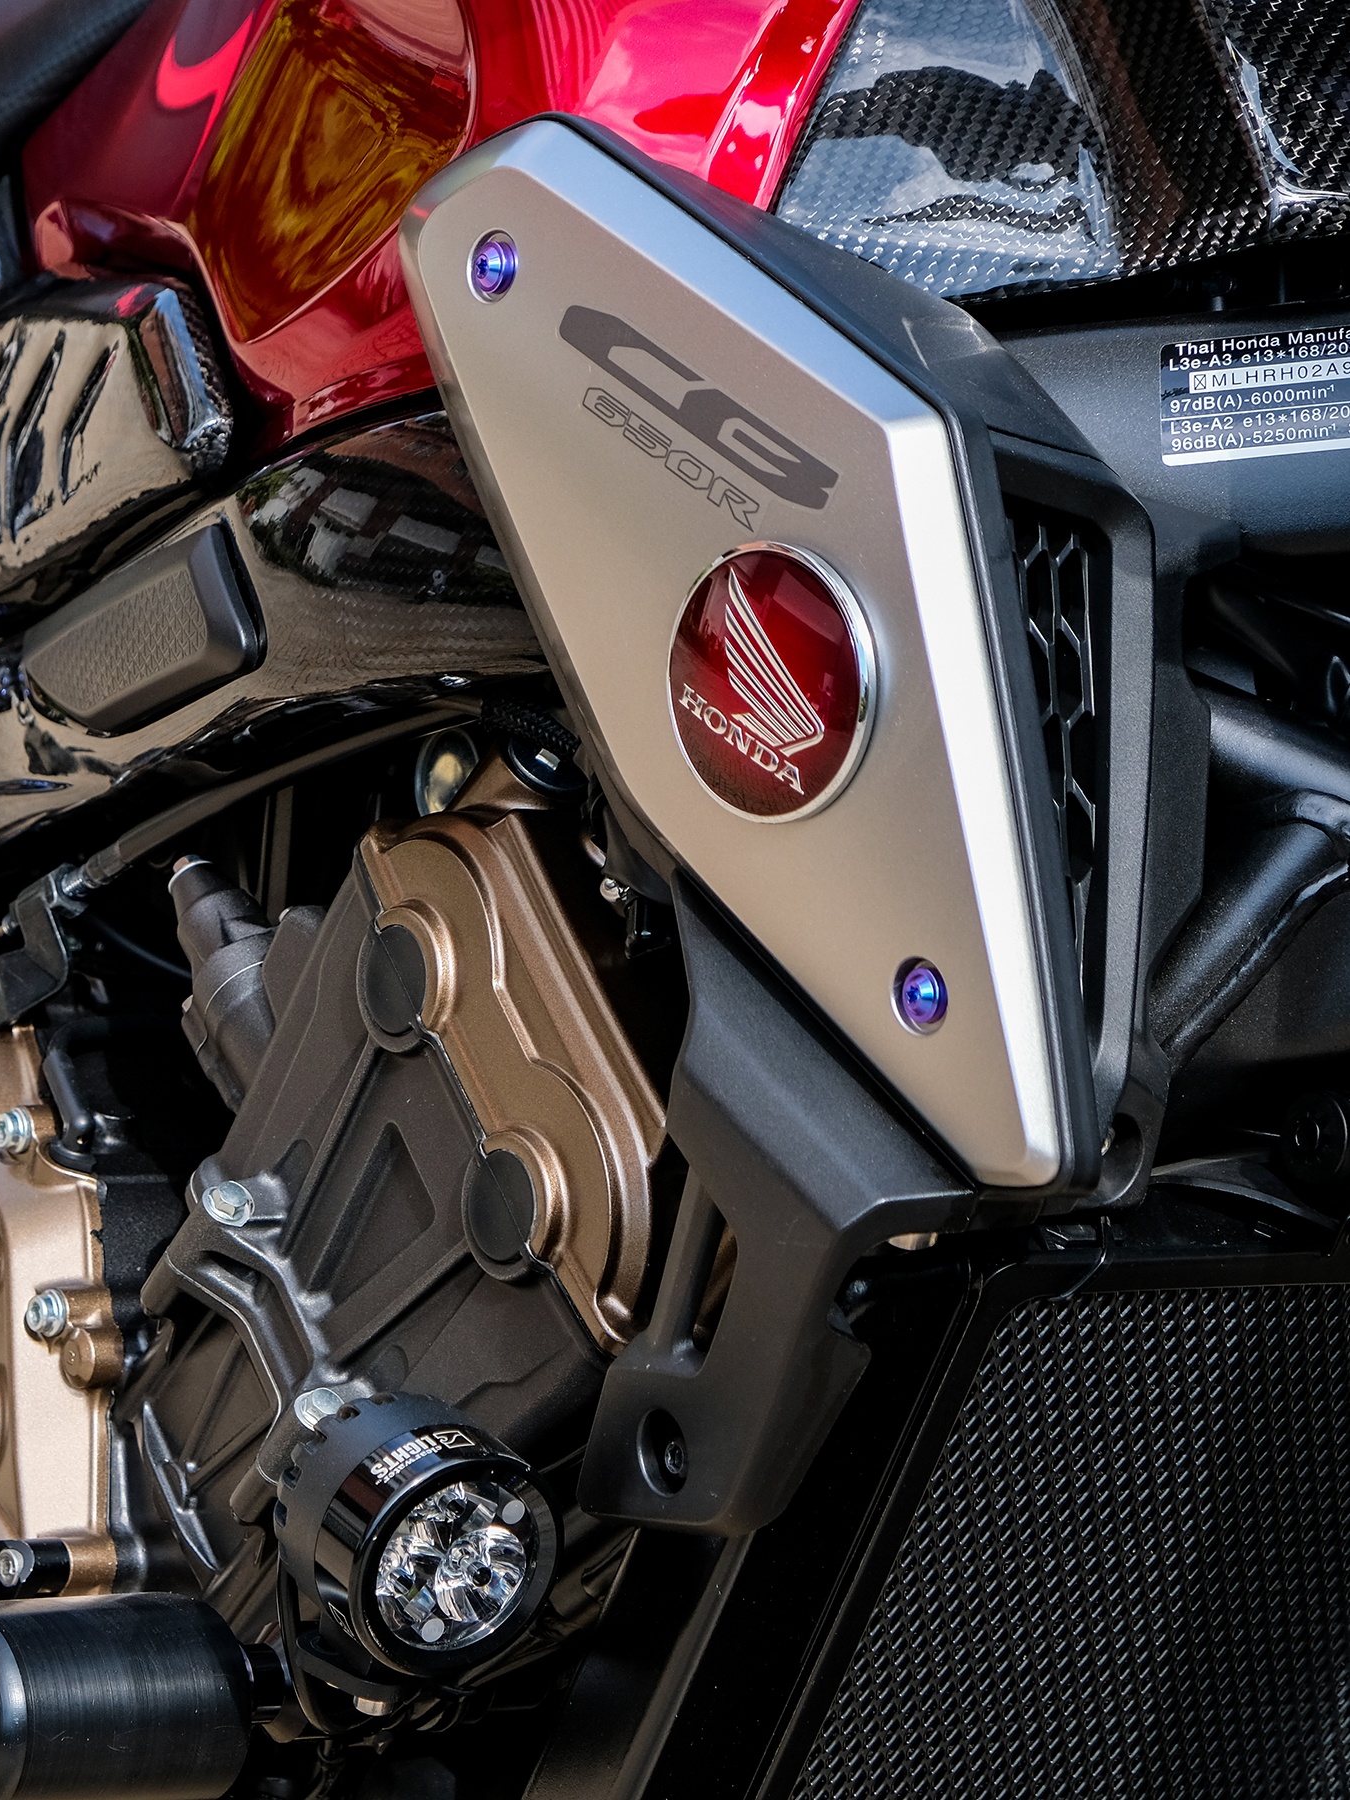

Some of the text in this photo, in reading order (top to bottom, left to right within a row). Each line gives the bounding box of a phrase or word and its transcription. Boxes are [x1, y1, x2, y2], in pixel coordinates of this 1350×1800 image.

[1169, 353, 1233, 372] L3e-A3
[1175, 340, 1215, 357] Thai
[1222, 335, 1281, 352] Honda
[559, 304, 840, 510] CB
[1170, 416, 1234, 435] L3e-A2
[582, 386, 760, 533] 650R
[678, 682, 805, 796] HONDA
[370, 1434, 438, 1480] LIGHTS
